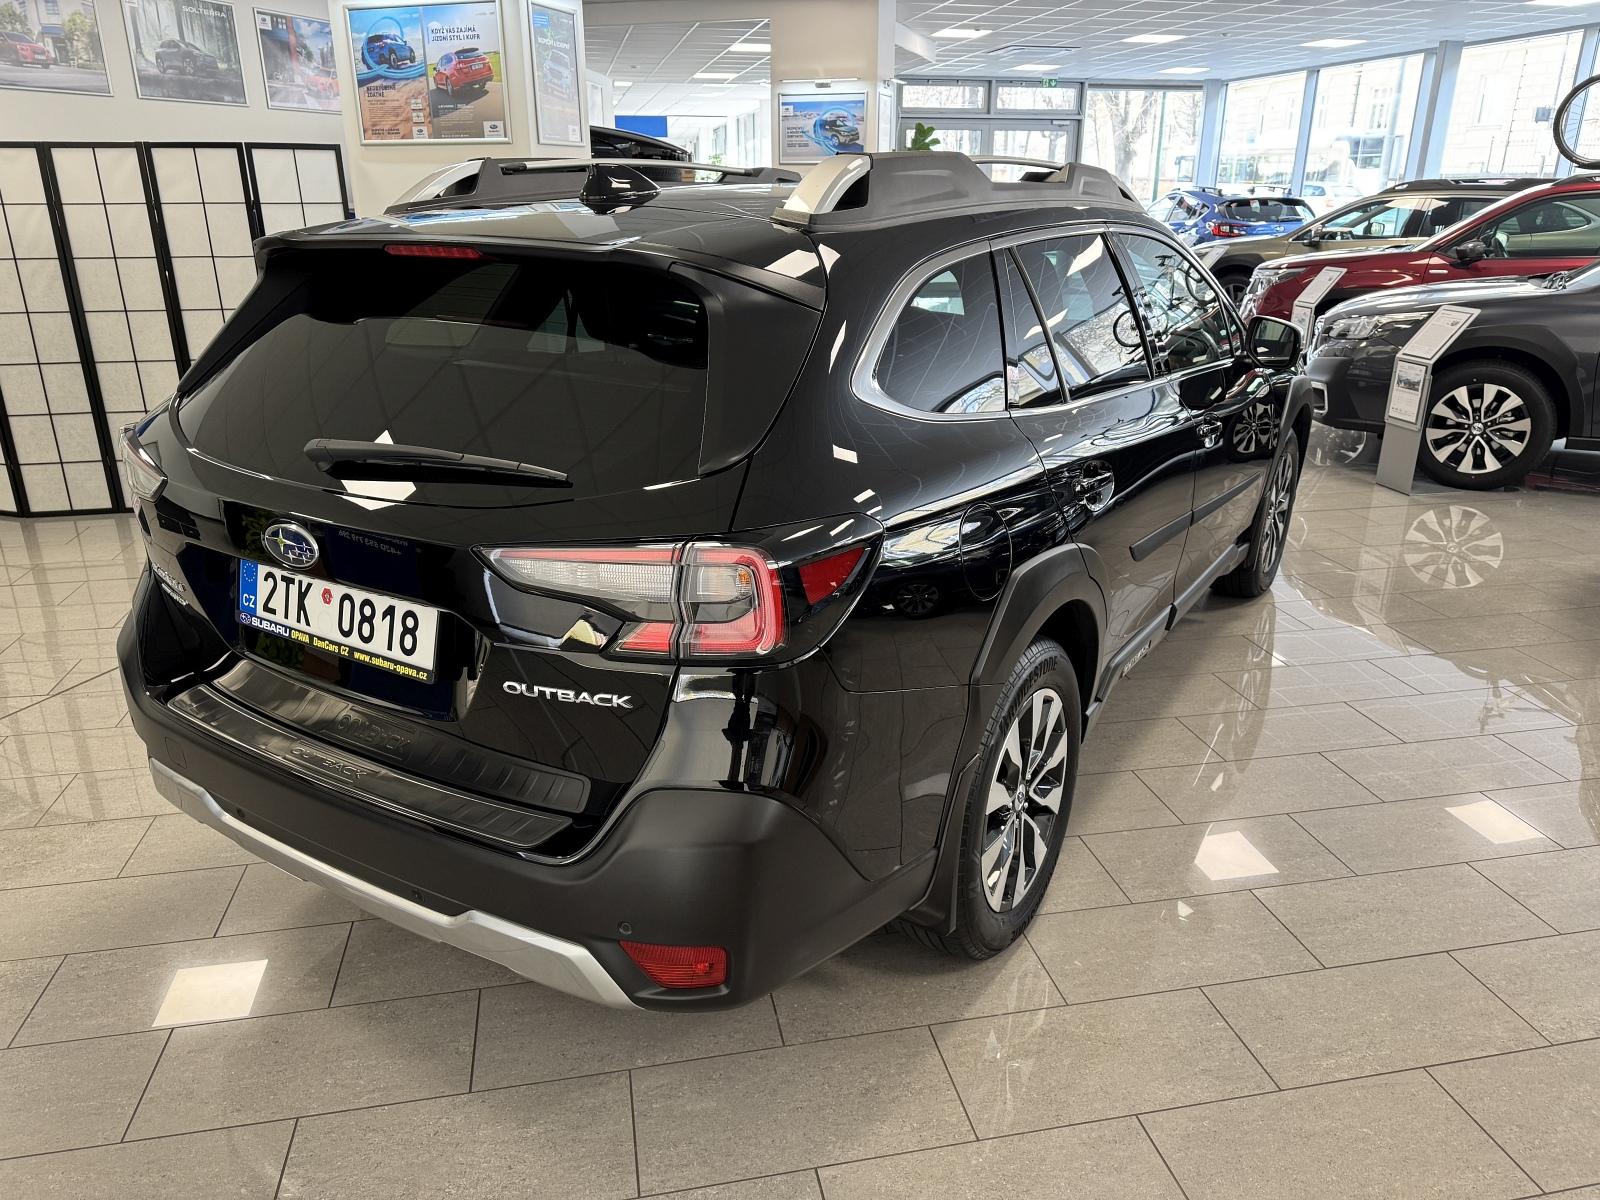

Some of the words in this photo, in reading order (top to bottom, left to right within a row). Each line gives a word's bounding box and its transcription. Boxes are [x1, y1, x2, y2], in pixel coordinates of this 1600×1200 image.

[182, 5, 226, 18] SOLTERRA
[243, 593, 255, 608] CZ
[263, 572, 313, 627] 2TK
[338, 593, 419, 656] 0818
[251, 617, 289, 637] SUBARU
[291, 630, 310, 644] OPAVA
[313, 637, 339, 653] DanCars
[340, 646, 350, 656] CZ
[354, 651, 428, 680] www.subaru-opava.cz
[502, 680, 633, 709] OUTBACK
